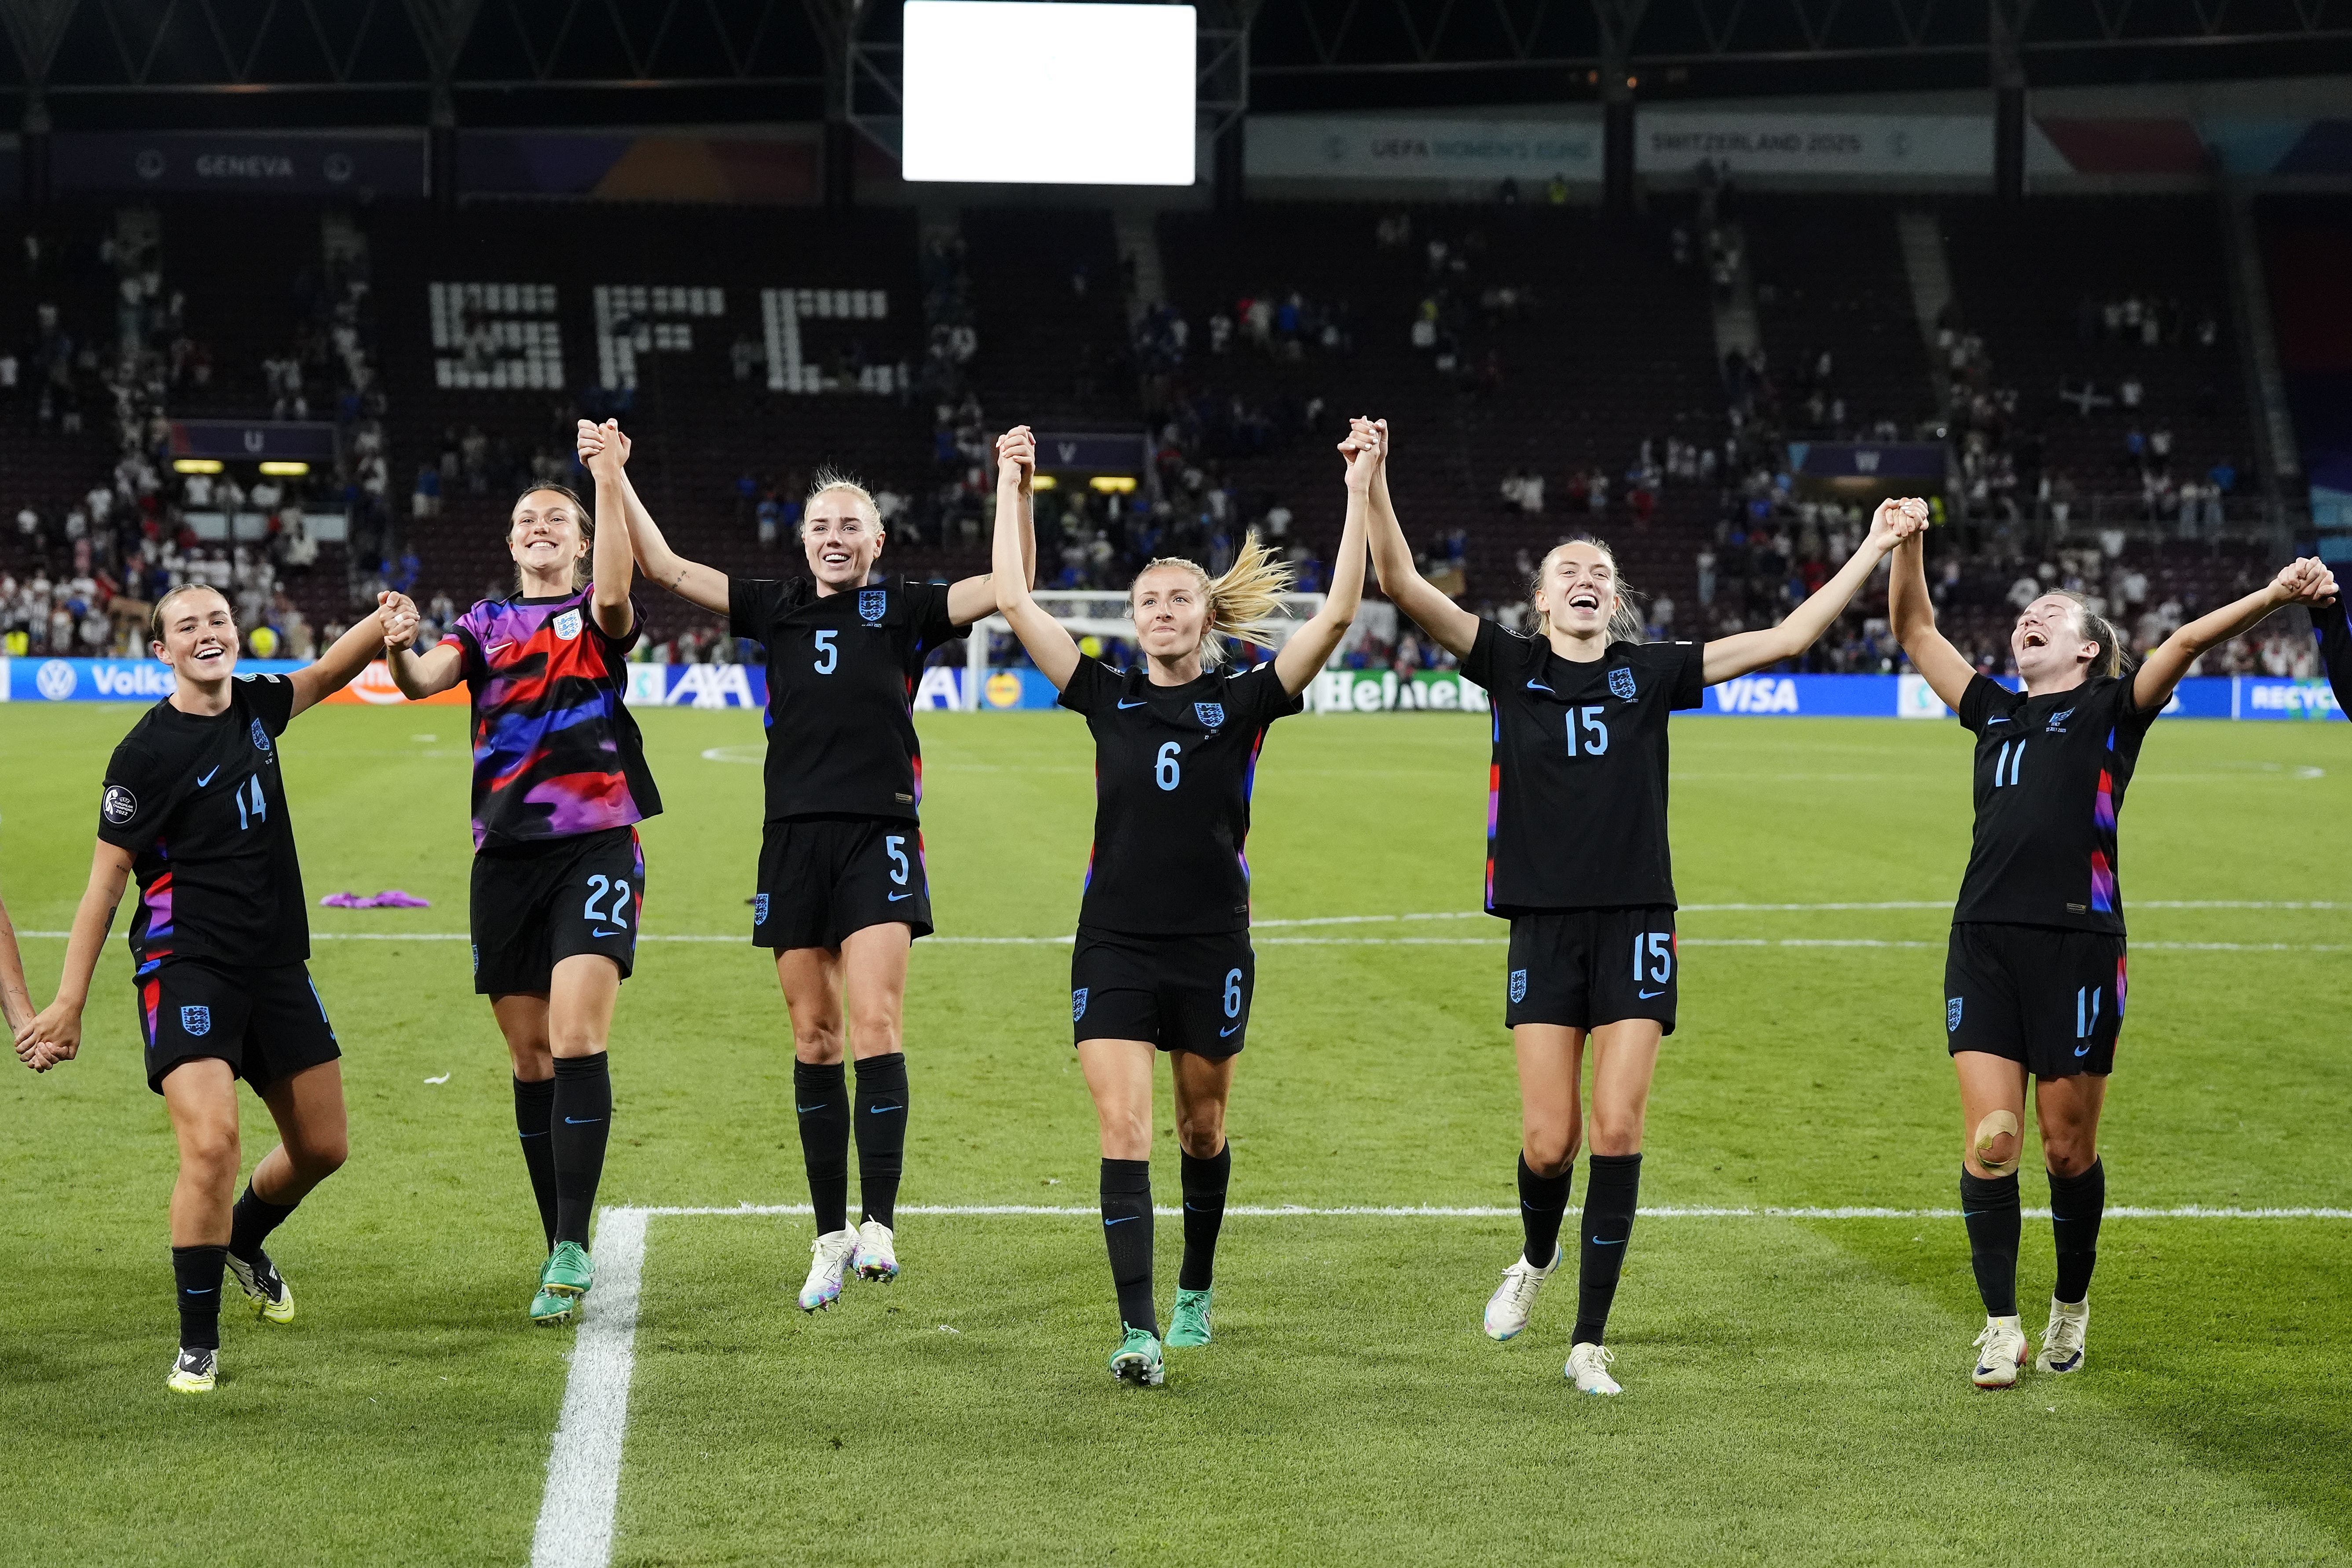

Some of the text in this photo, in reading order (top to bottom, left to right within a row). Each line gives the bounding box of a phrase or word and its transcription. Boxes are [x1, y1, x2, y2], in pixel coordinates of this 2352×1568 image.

[1370, 139, 1429, 159] UEFA
[1651, 132, 1862, 154] SWITZERLAND 2025
[196, 155, 293, 177] GENEVA
[244, 430, 265, 453] U
[1058, 442, 1078, 464] V
[814, 630, 838, 674] 5
[665, 663, 756, 708] AXA
[1716, 678, 1799, 712] VISA
[1565, 706, 1609, 757] 15
[1154, 741, 1181, 791] 6
[1995, 738, 2027, 788] 11
[113, 803, 133, 812] CHAMPIONS
[114, 800, 133, 809] EUROPEAN
[236, 773, 266, 830] 14
[885, 835, 909, 886] 5
[584, 874, 630, 929] 22
[1633, 932, 1671, 985] 15
[1222, 968, 1242, 1018] 6
[2077, 985, 2102, 1038] 11
